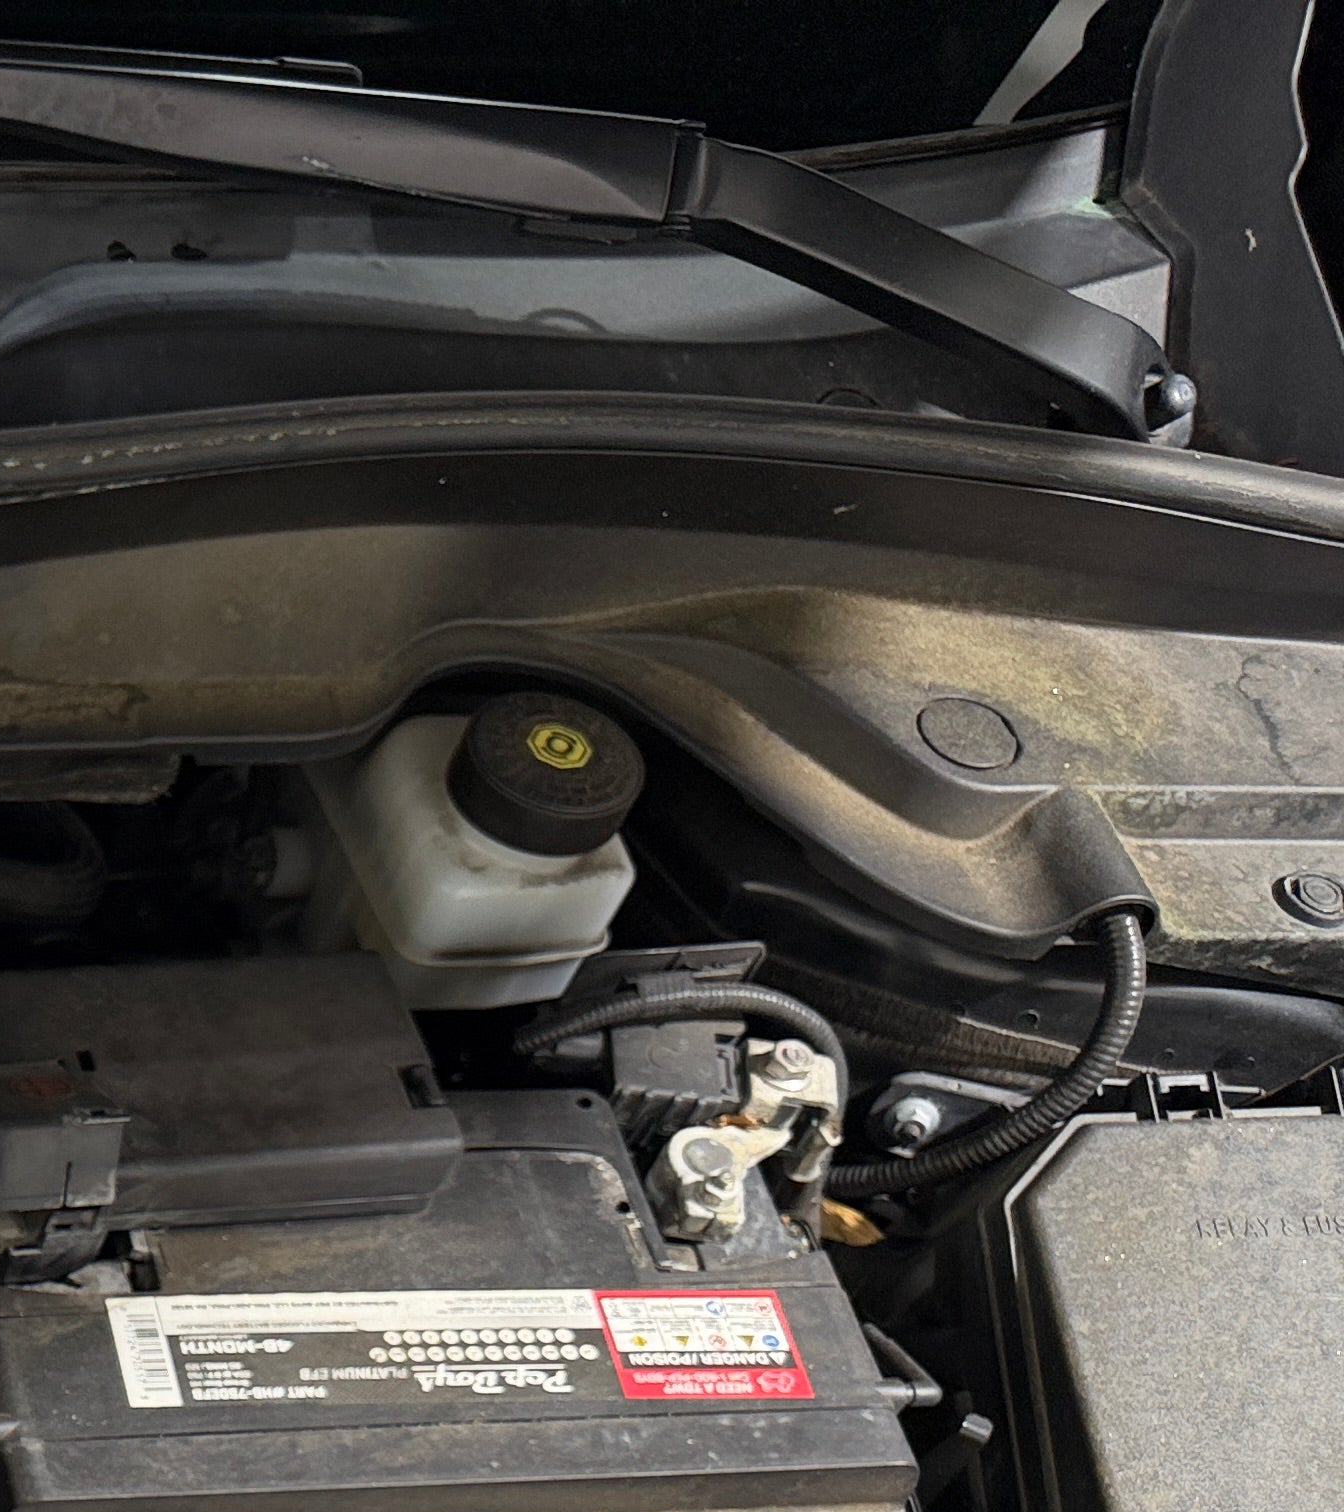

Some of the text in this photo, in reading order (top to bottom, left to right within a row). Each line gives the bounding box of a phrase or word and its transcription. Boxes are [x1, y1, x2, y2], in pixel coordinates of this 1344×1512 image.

[1196, 1216, 1272, 1239] RELAY
[299, 1365, 412, 1381] PLATINUM EFB
[414, 1362, 577, 1394] Pep Boys
[288, 1385, 329, 1399] PART
[663, 1382, 753, 1394] NEED A TOW?
